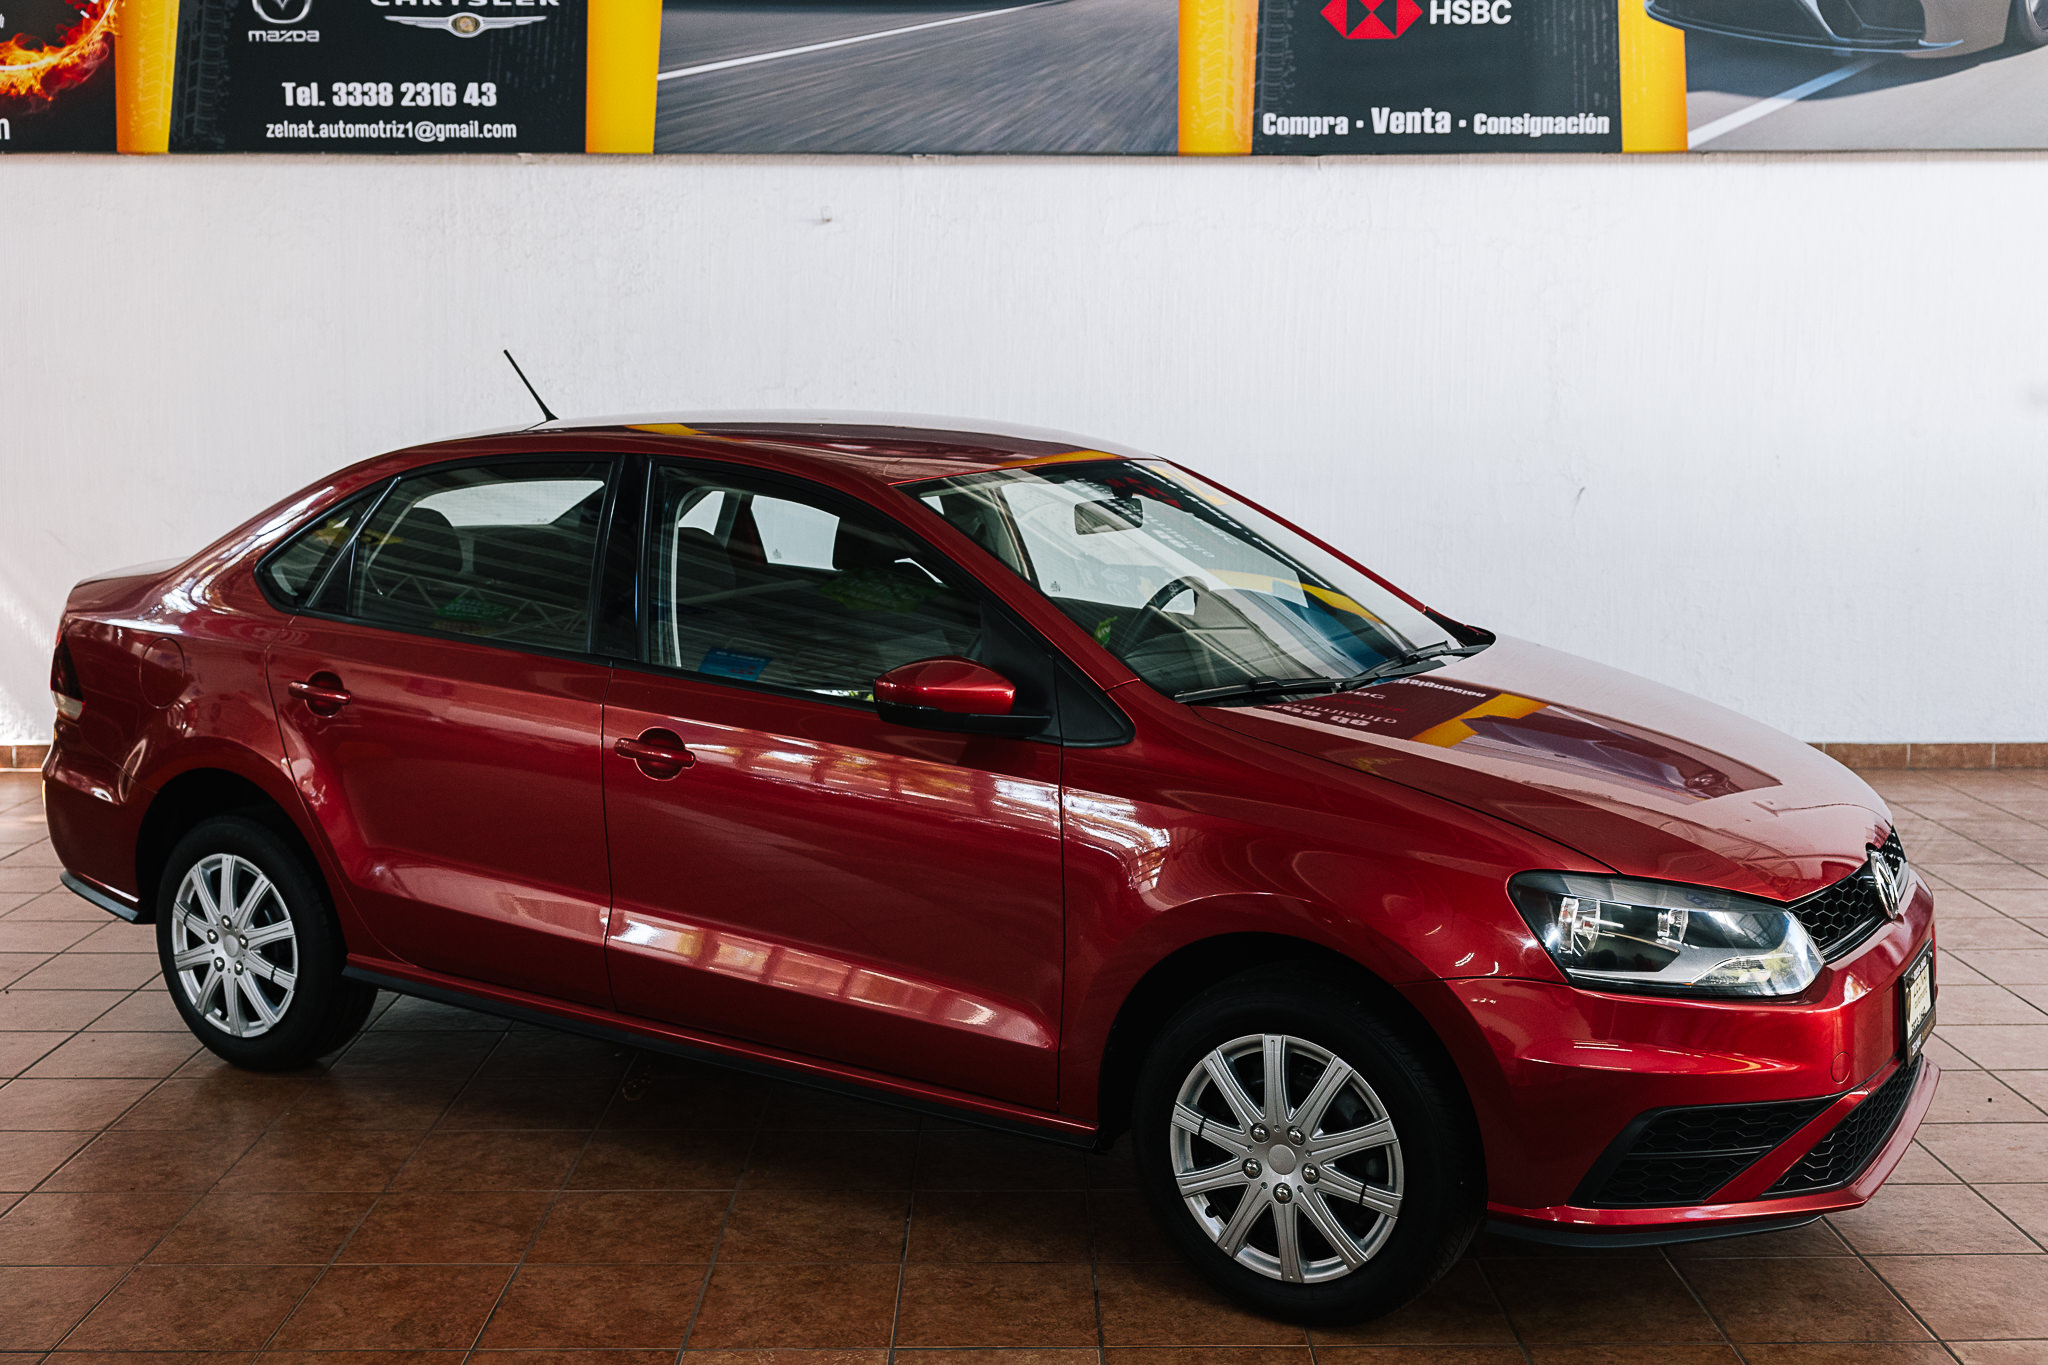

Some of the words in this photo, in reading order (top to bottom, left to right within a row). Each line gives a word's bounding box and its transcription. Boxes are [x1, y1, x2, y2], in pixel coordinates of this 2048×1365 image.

[1429, 0, 1512, 25] HSBC
[281, 81, 325, 107] Tel.
[332, 81, 393, 107] 3338
[400, 81, 456, 107] 2316
[462, 81, 497, 107] 43
[265, 119, 517, 142] zelnat.automotriz1@gmail.com
[1262, 112, 1349, 138] Compra
[1370, 106, 1452, 134] Venta
[1473, 112, 1610, 137] Consignación
